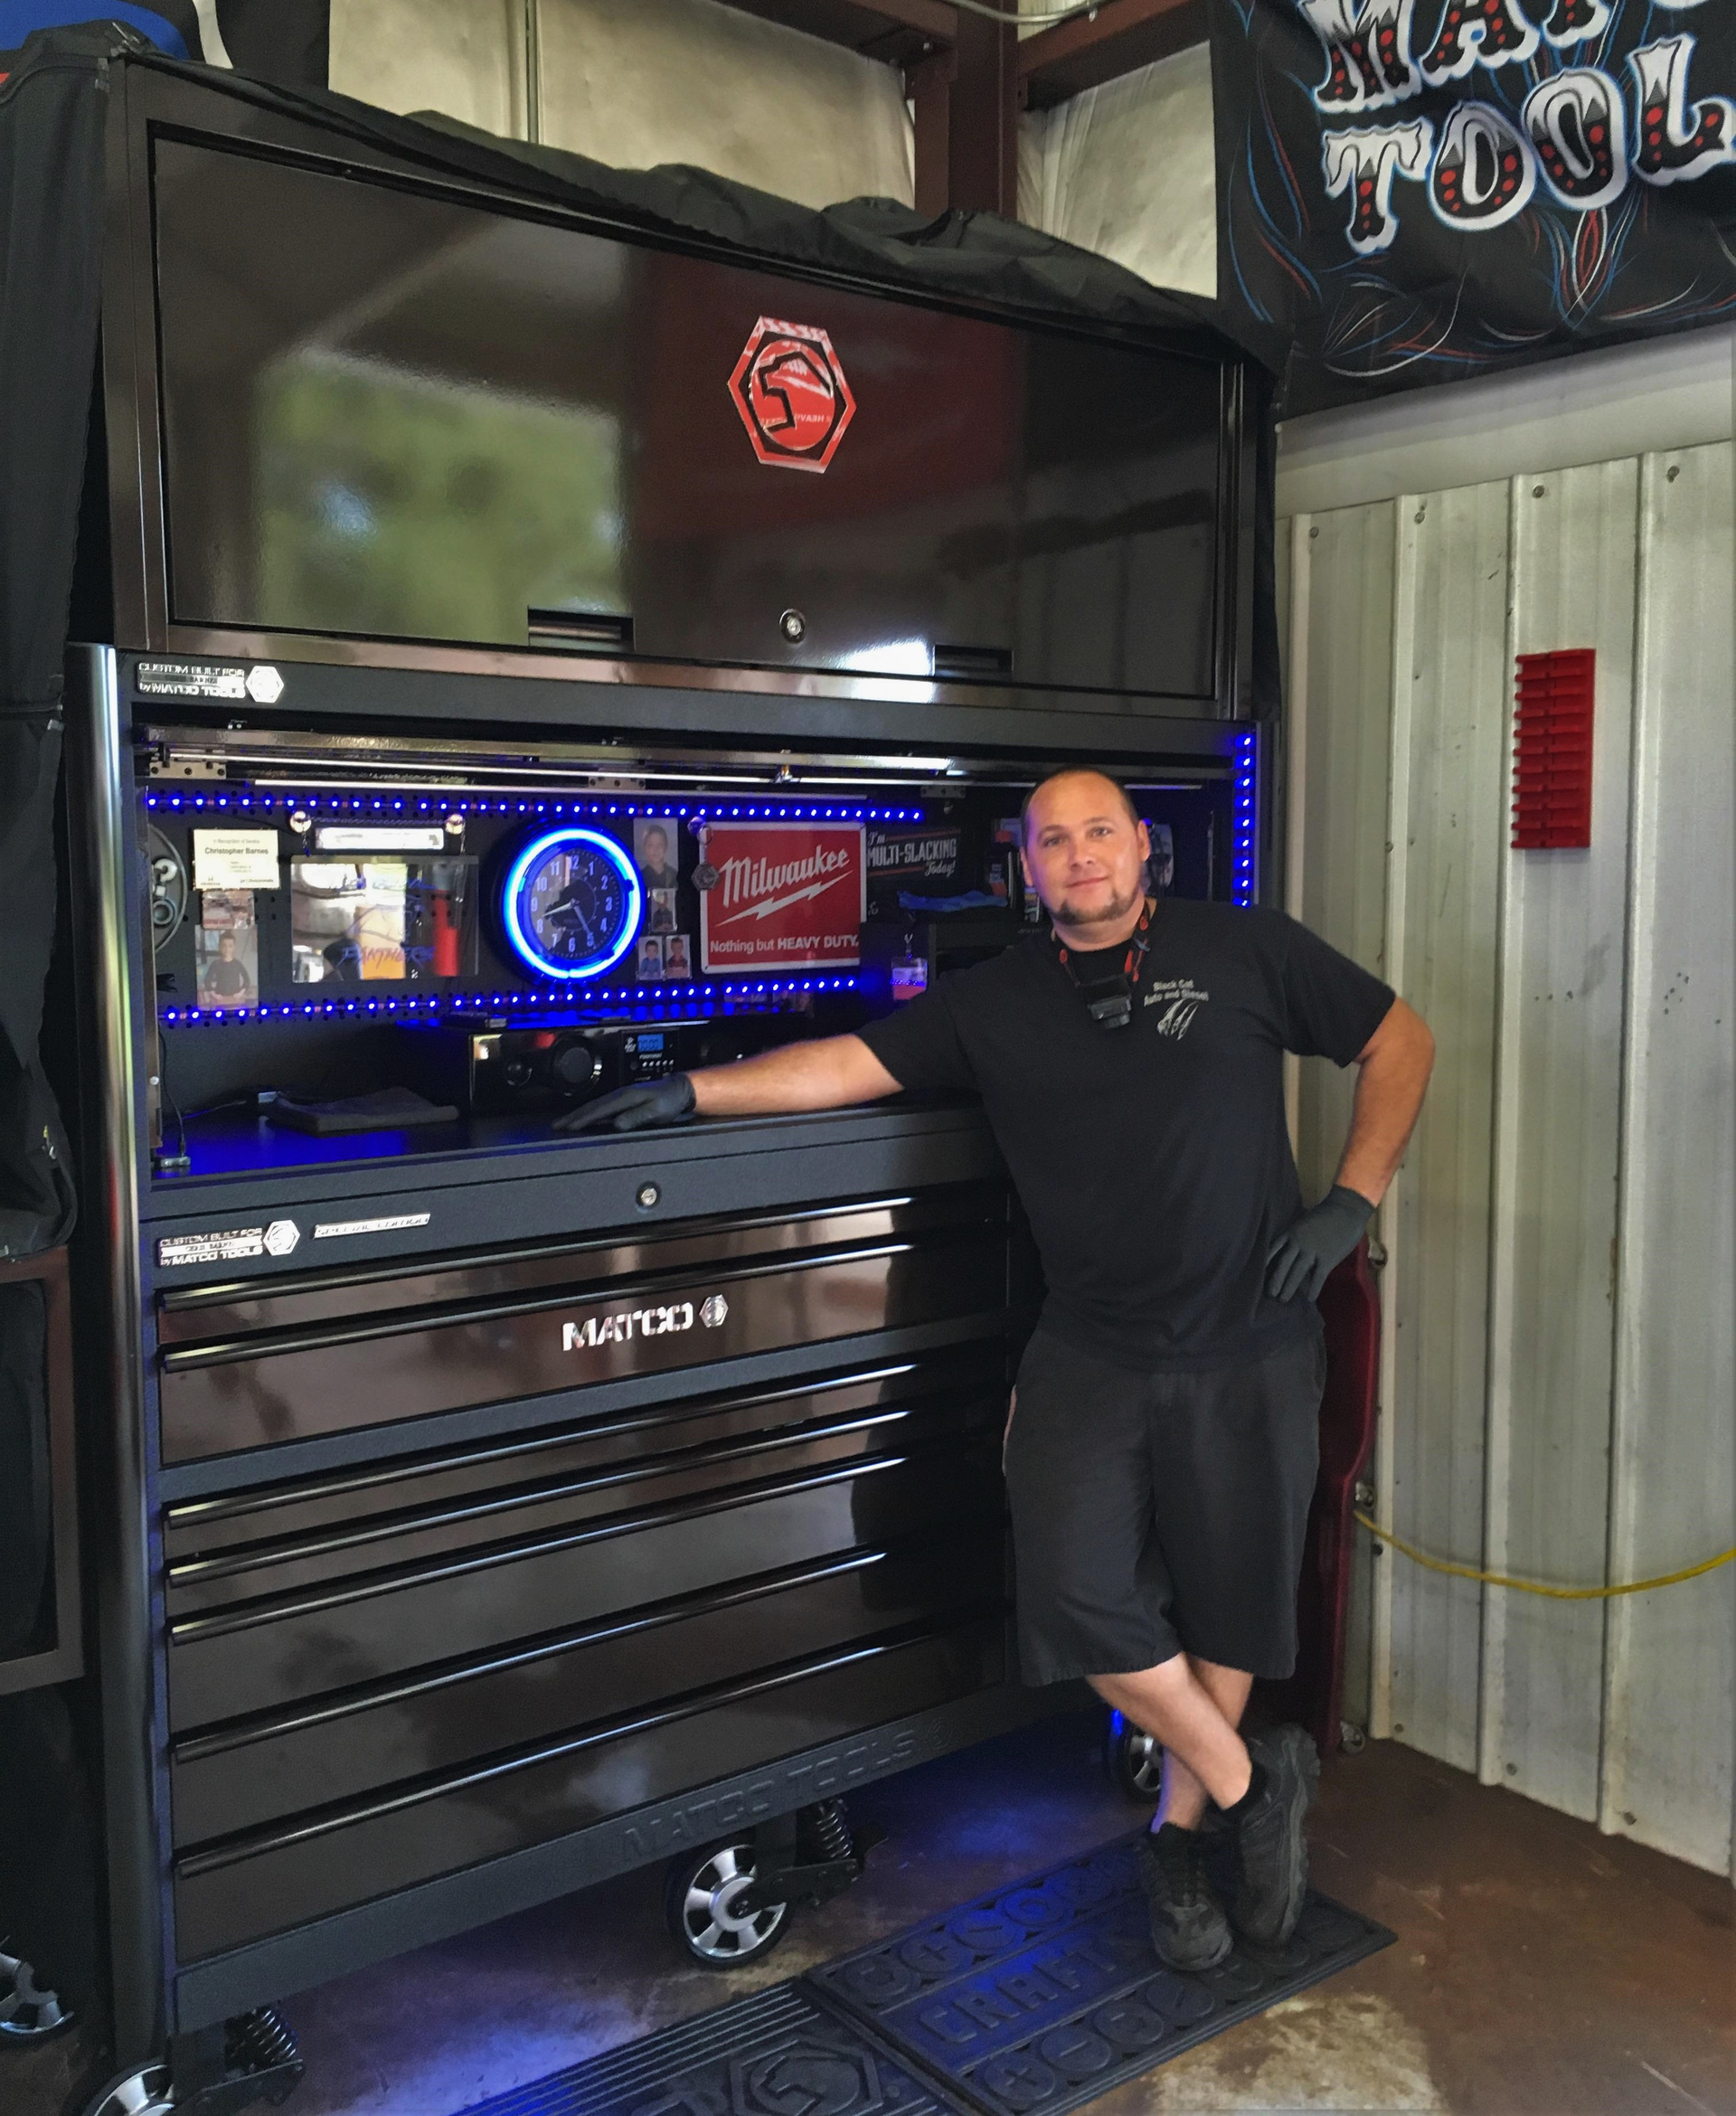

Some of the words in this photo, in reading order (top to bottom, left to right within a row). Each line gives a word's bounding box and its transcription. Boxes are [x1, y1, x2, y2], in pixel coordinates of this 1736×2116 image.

[1320, 33, 1736, 254] TOOL
[138, 662, 189, 675] CUSTOM
[192, 666, 221, 676] BUILT
[222, 668, 245, 677] FOR
[152, 683, 200, 695] MATCO
[868, 831, 886, 845] I'm
[204, 846, 244, 855] Christopher
[867, 837, 958, 867] MULTI-SLACKING
[551, 861, 560, 875] 11
[570, 855, 580, 870] 12
[589, 862, 594, 876] 1
[925, 860, 956, 877] Today!
[536, 877, 548, 892] 10
[601, 875, 608, 890] 2
[719, 845, 851, 909] Milwaukee
[531, 897, 538, 912] 9
[606, 896, 612, 912] 3
[537, 919, 542, 933] 8
[600, 918, 607, 932] 4
[552, 932, 558, 948] 7
[569, 937, 575, 952] 6
[710, 940, 754, 955] Nothing
[757, 939, 774, 951] but
[778, 936, 821, 949] HEAVY
[1153, 979, 1177, 992] Black
[1144, 992, 1163, 1007] Auto
[1164, 988, 1180, 1000] and
[159, 1233, 208, 1247] CUSTOM
[211, 1230, 240, 1242] BUILT
[241, 1227, 263, 1237] FOR
[160, 1257, 172, 1266] by
[172, 1251, 218, 1266] MATCO
[220, 1245, 263, 1260] TOOLS
[562, 1302, 693, 1352] MATCO
